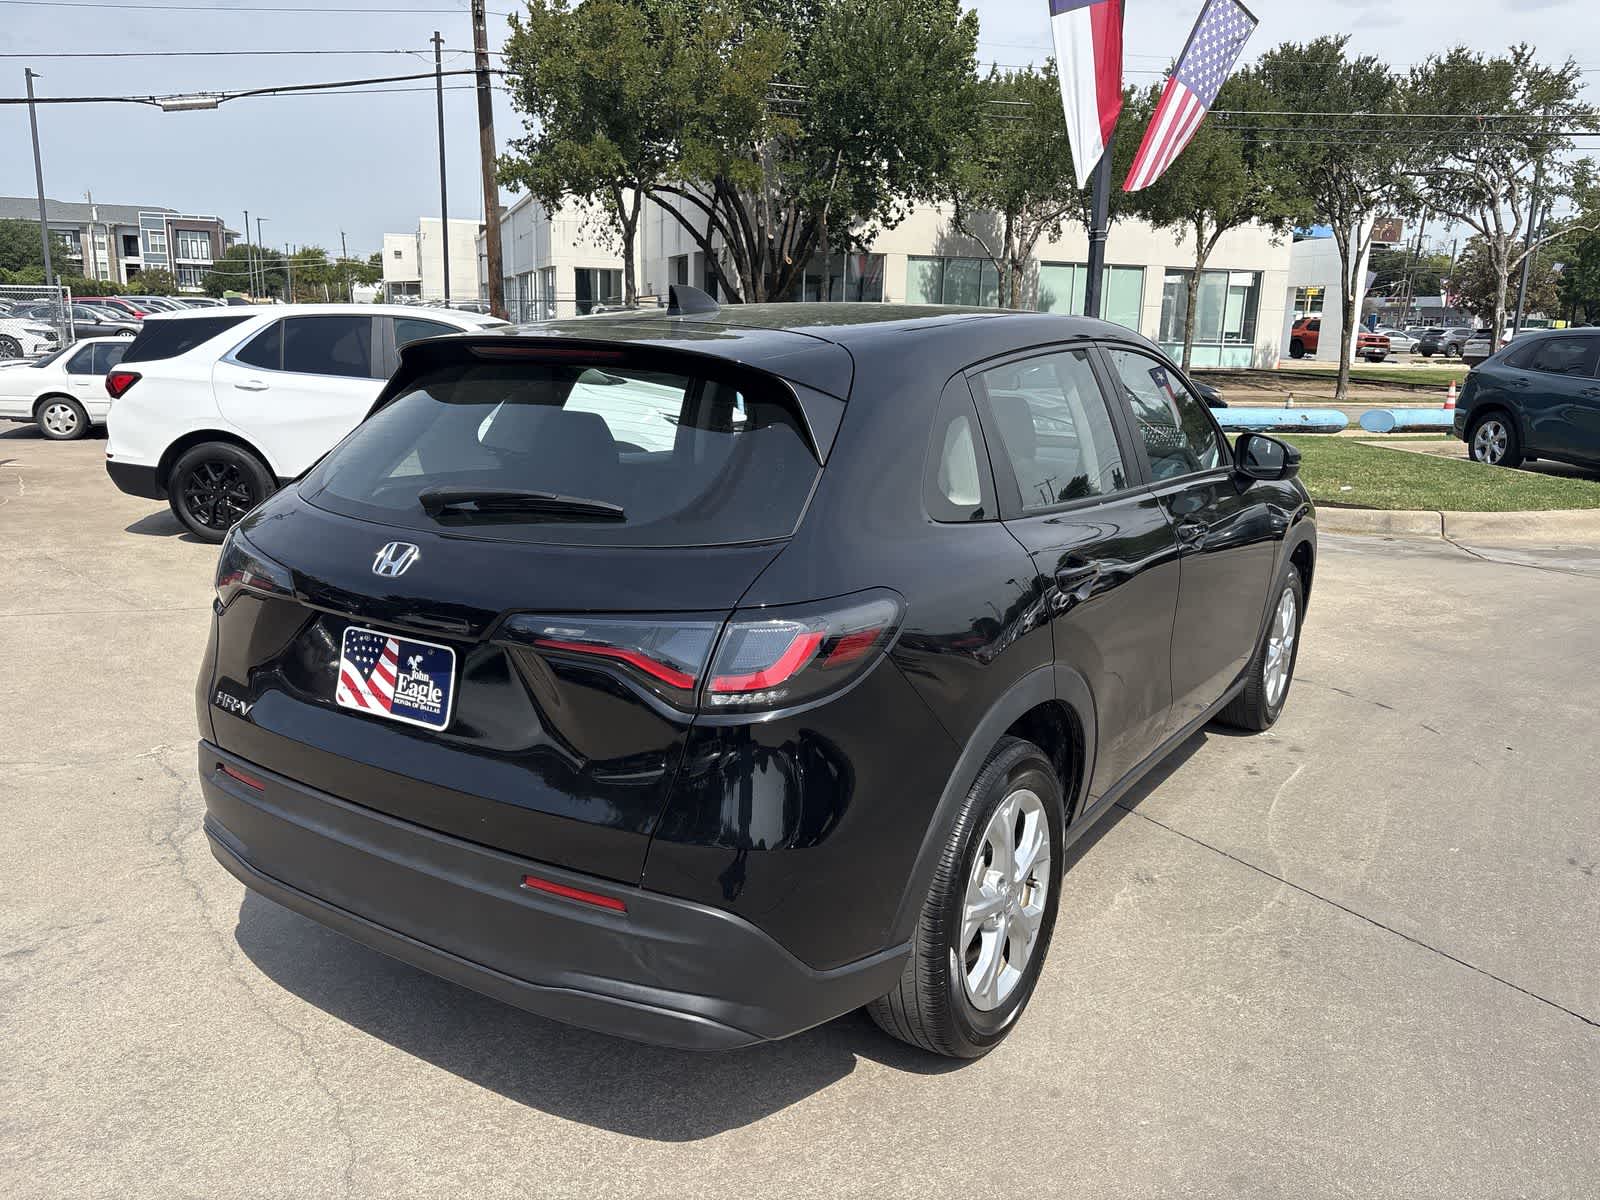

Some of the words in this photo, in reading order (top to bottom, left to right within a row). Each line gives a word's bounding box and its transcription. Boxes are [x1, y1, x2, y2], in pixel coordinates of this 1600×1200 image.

[396, 673, 442, 704] Eagle
[410, 670, 429, 682] John
[215, 691, 254, 716] HR-V
